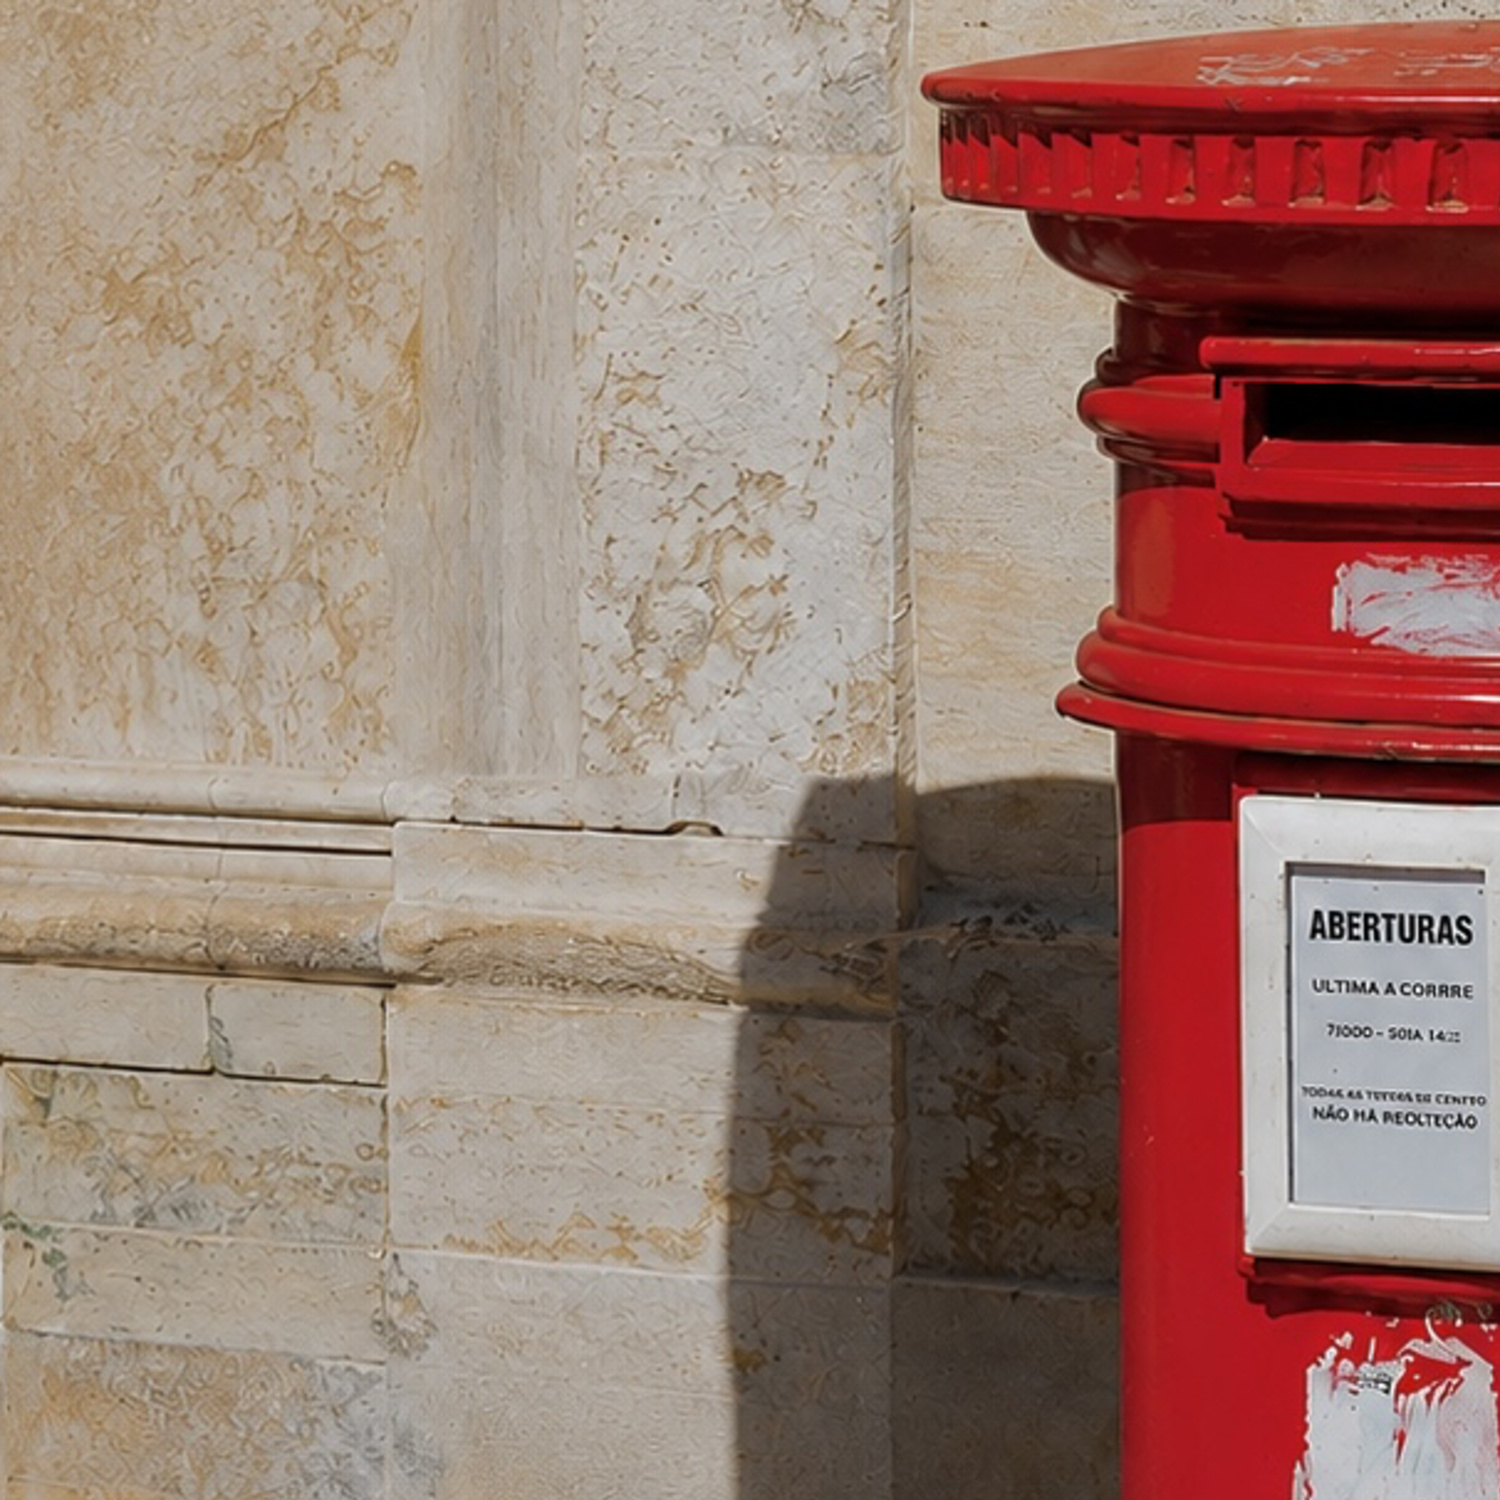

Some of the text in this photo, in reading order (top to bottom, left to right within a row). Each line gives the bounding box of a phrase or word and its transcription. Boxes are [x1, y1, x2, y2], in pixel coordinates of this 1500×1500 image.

[1309, 909, 1474, 946] ABERTURAS
[1312, 979, 1380, 996] ULTIMA
[1383, 982, 1397, 996] A
[1312, 1102, 1350, 1122] NÃO
